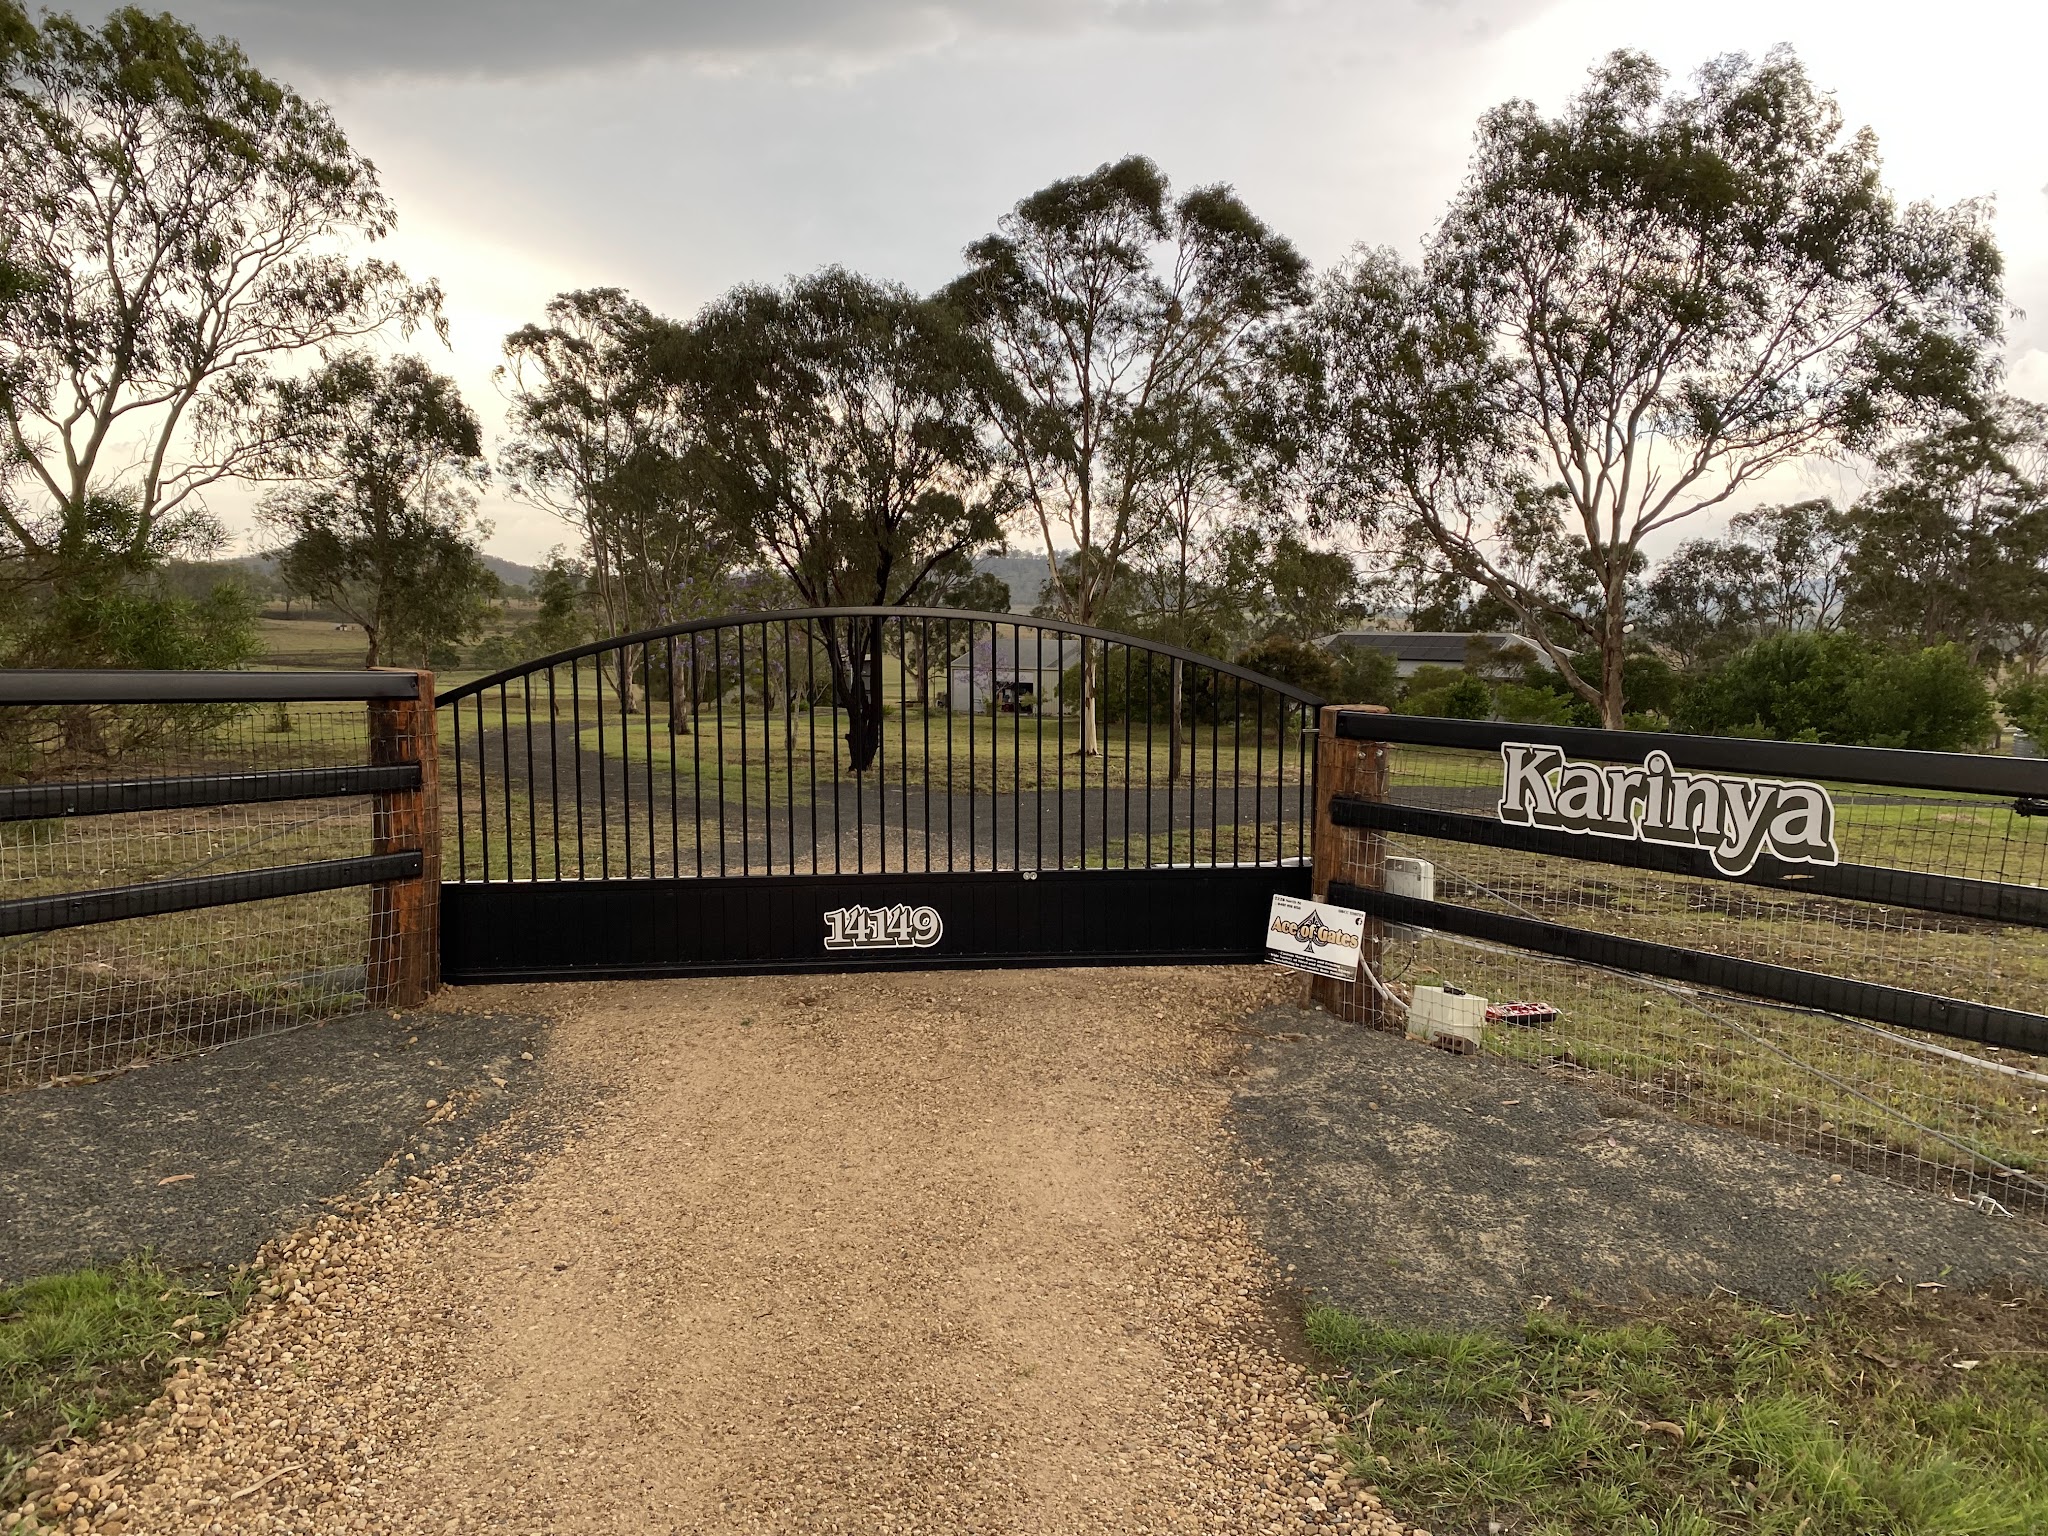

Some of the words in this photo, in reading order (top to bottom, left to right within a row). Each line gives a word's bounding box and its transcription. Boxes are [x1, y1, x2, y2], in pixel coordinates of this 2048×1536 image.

[1501, 743, 1837, 875] Karinya
[825, 904, 943, 949] 14149
[1271, 916, 1298, 936] Ace
[1300, 924, 1317, 940] of
[1319, 926, 1359, 949] Gates
